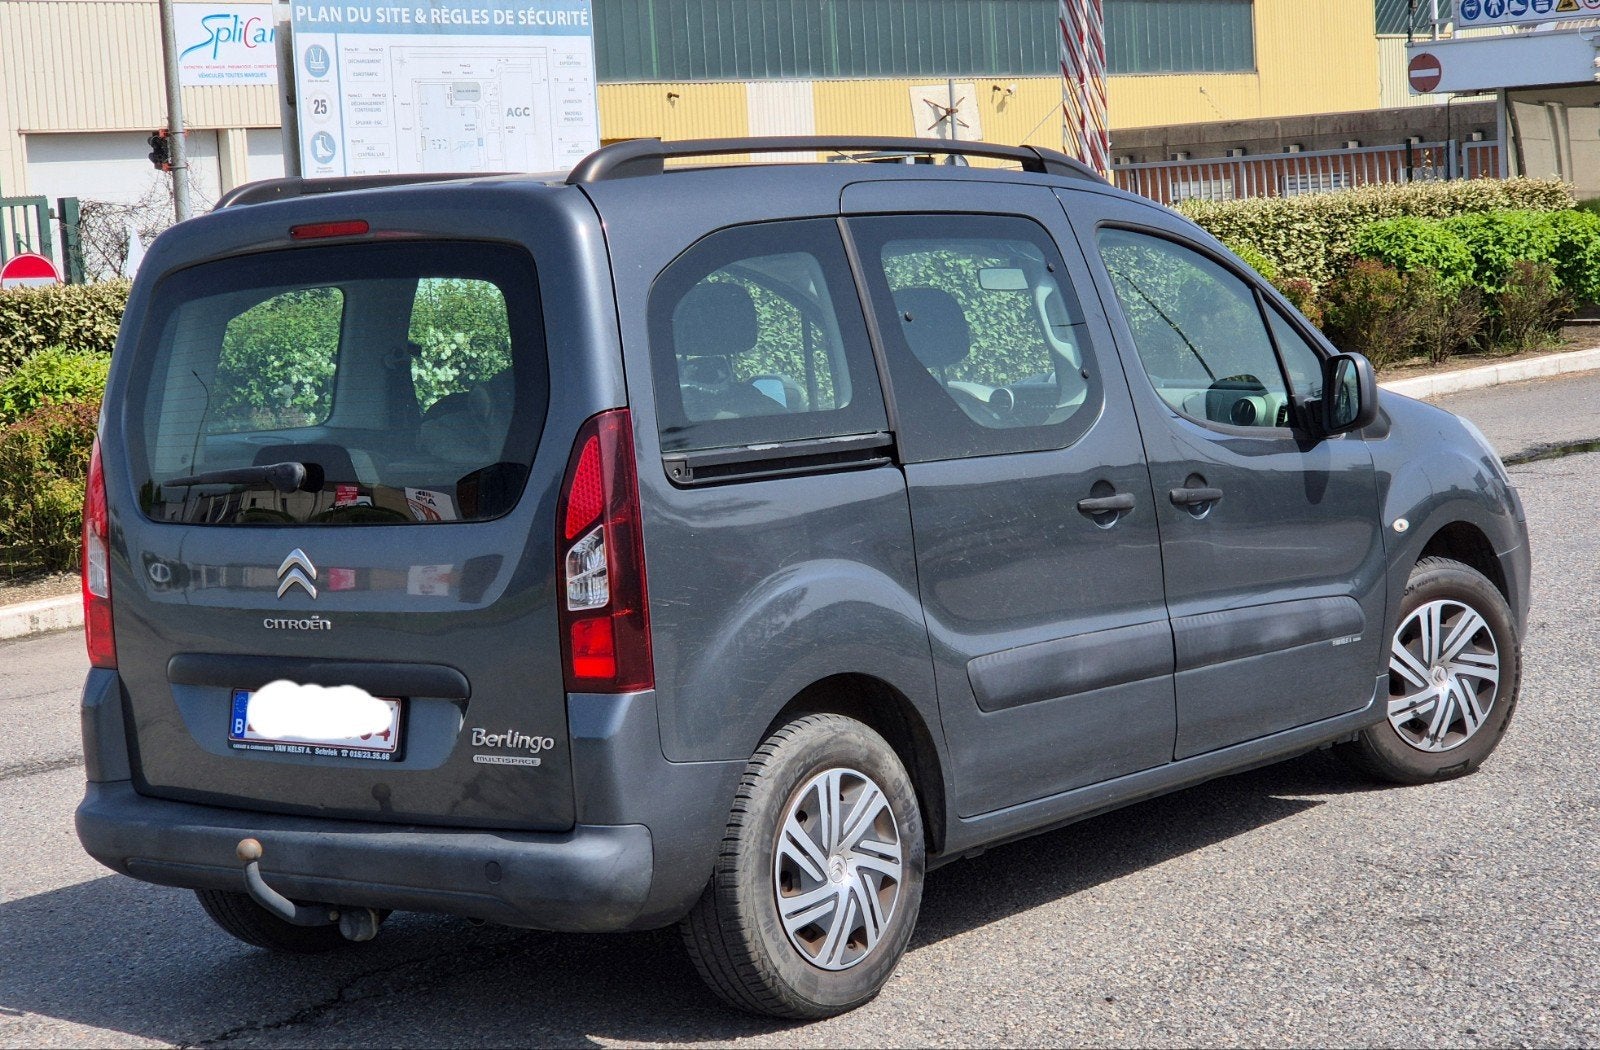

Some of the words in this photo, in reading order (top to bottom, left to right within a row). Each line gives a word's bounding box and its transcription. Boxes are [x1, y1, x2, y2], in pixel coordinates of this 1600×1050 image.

[296, 6, 342, 22] PLAN
[346, 7, 372, 23] DU
[376, 7, 411, 24] SITE
[415, 8, 426, 24] &
[430, 6, 489, 24] RÈGLES
[493, 9, 514, 25] DE
[518, 7, 589, 26] SÉCURITÉ
[313, 99, 328, 115] 25
[506, 107, 531, 118] AGC
[263, 615, 331, 630] CITROËN
[234, 718, 244, 734] B
[471, 727, 555, 754] Berlingo
[475, 756, 539, 766] MULTISPACE
